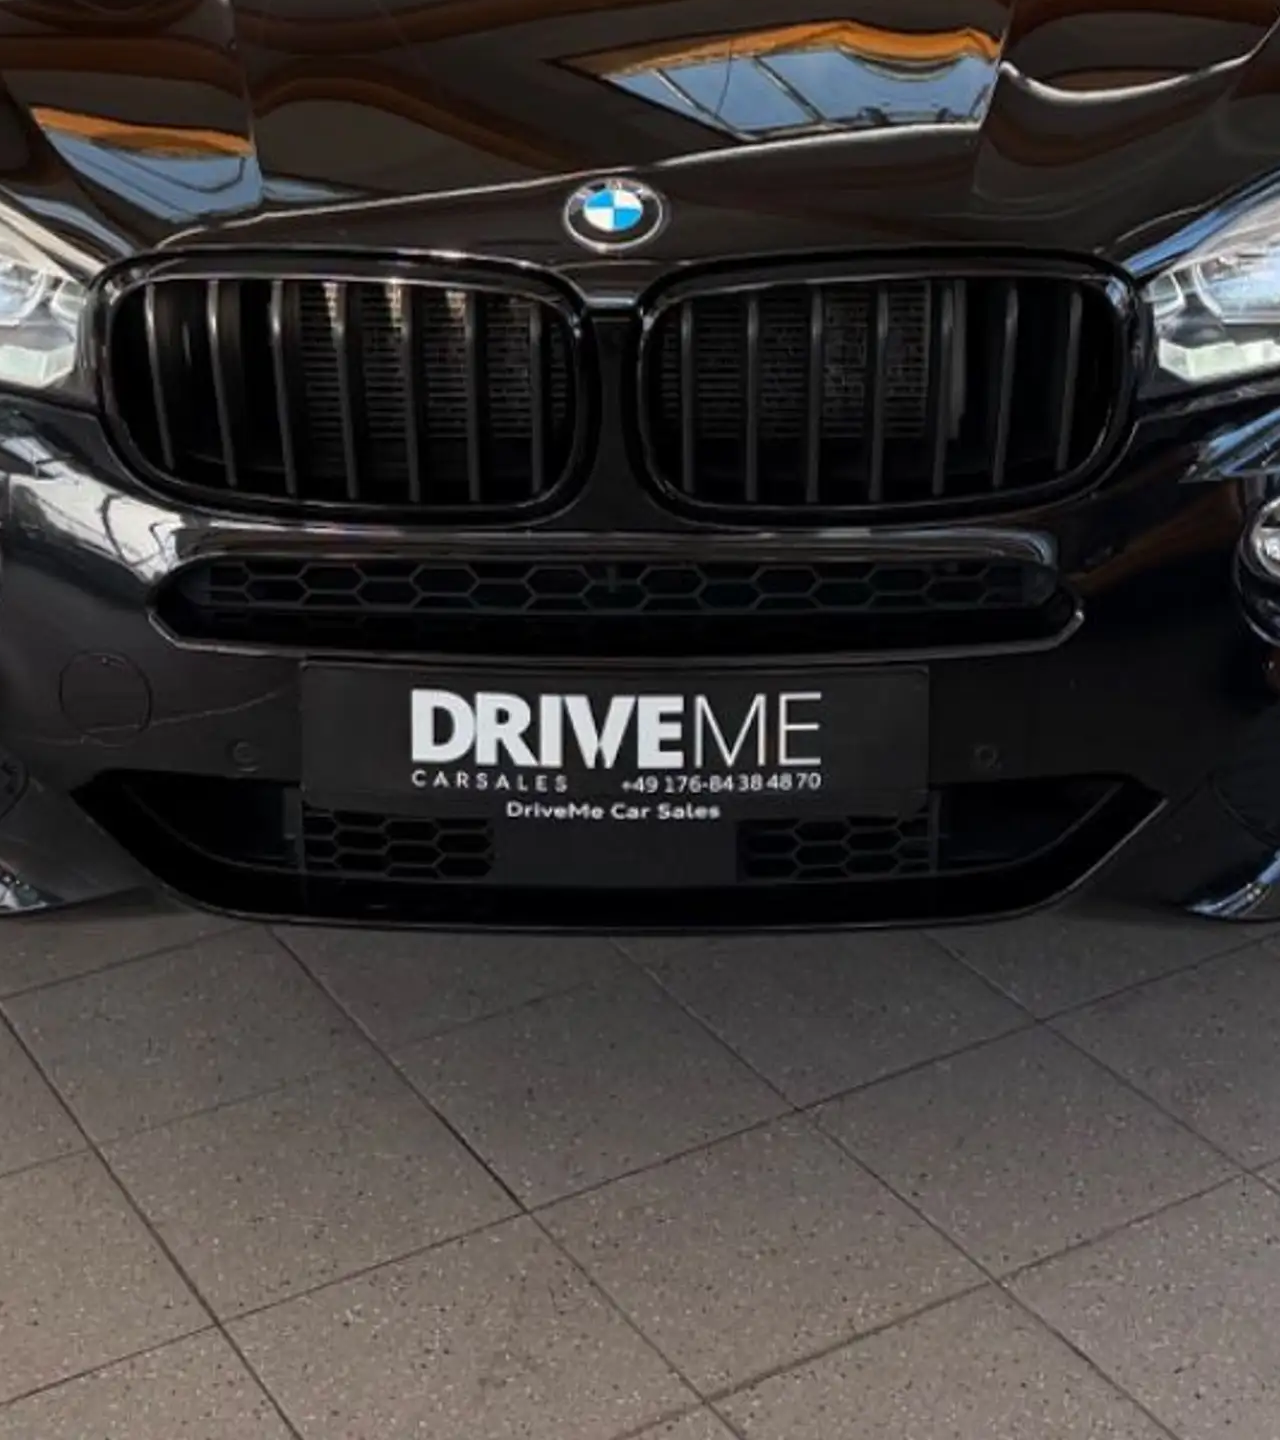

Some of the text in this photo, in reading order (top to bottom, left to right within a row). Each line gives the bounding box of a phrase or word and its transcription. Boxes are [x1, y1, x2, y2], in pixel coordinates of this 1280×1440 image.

[411, 769, 568, 793] CARSALES
[506, 800, 721, 820] DriveMe Car Sales
